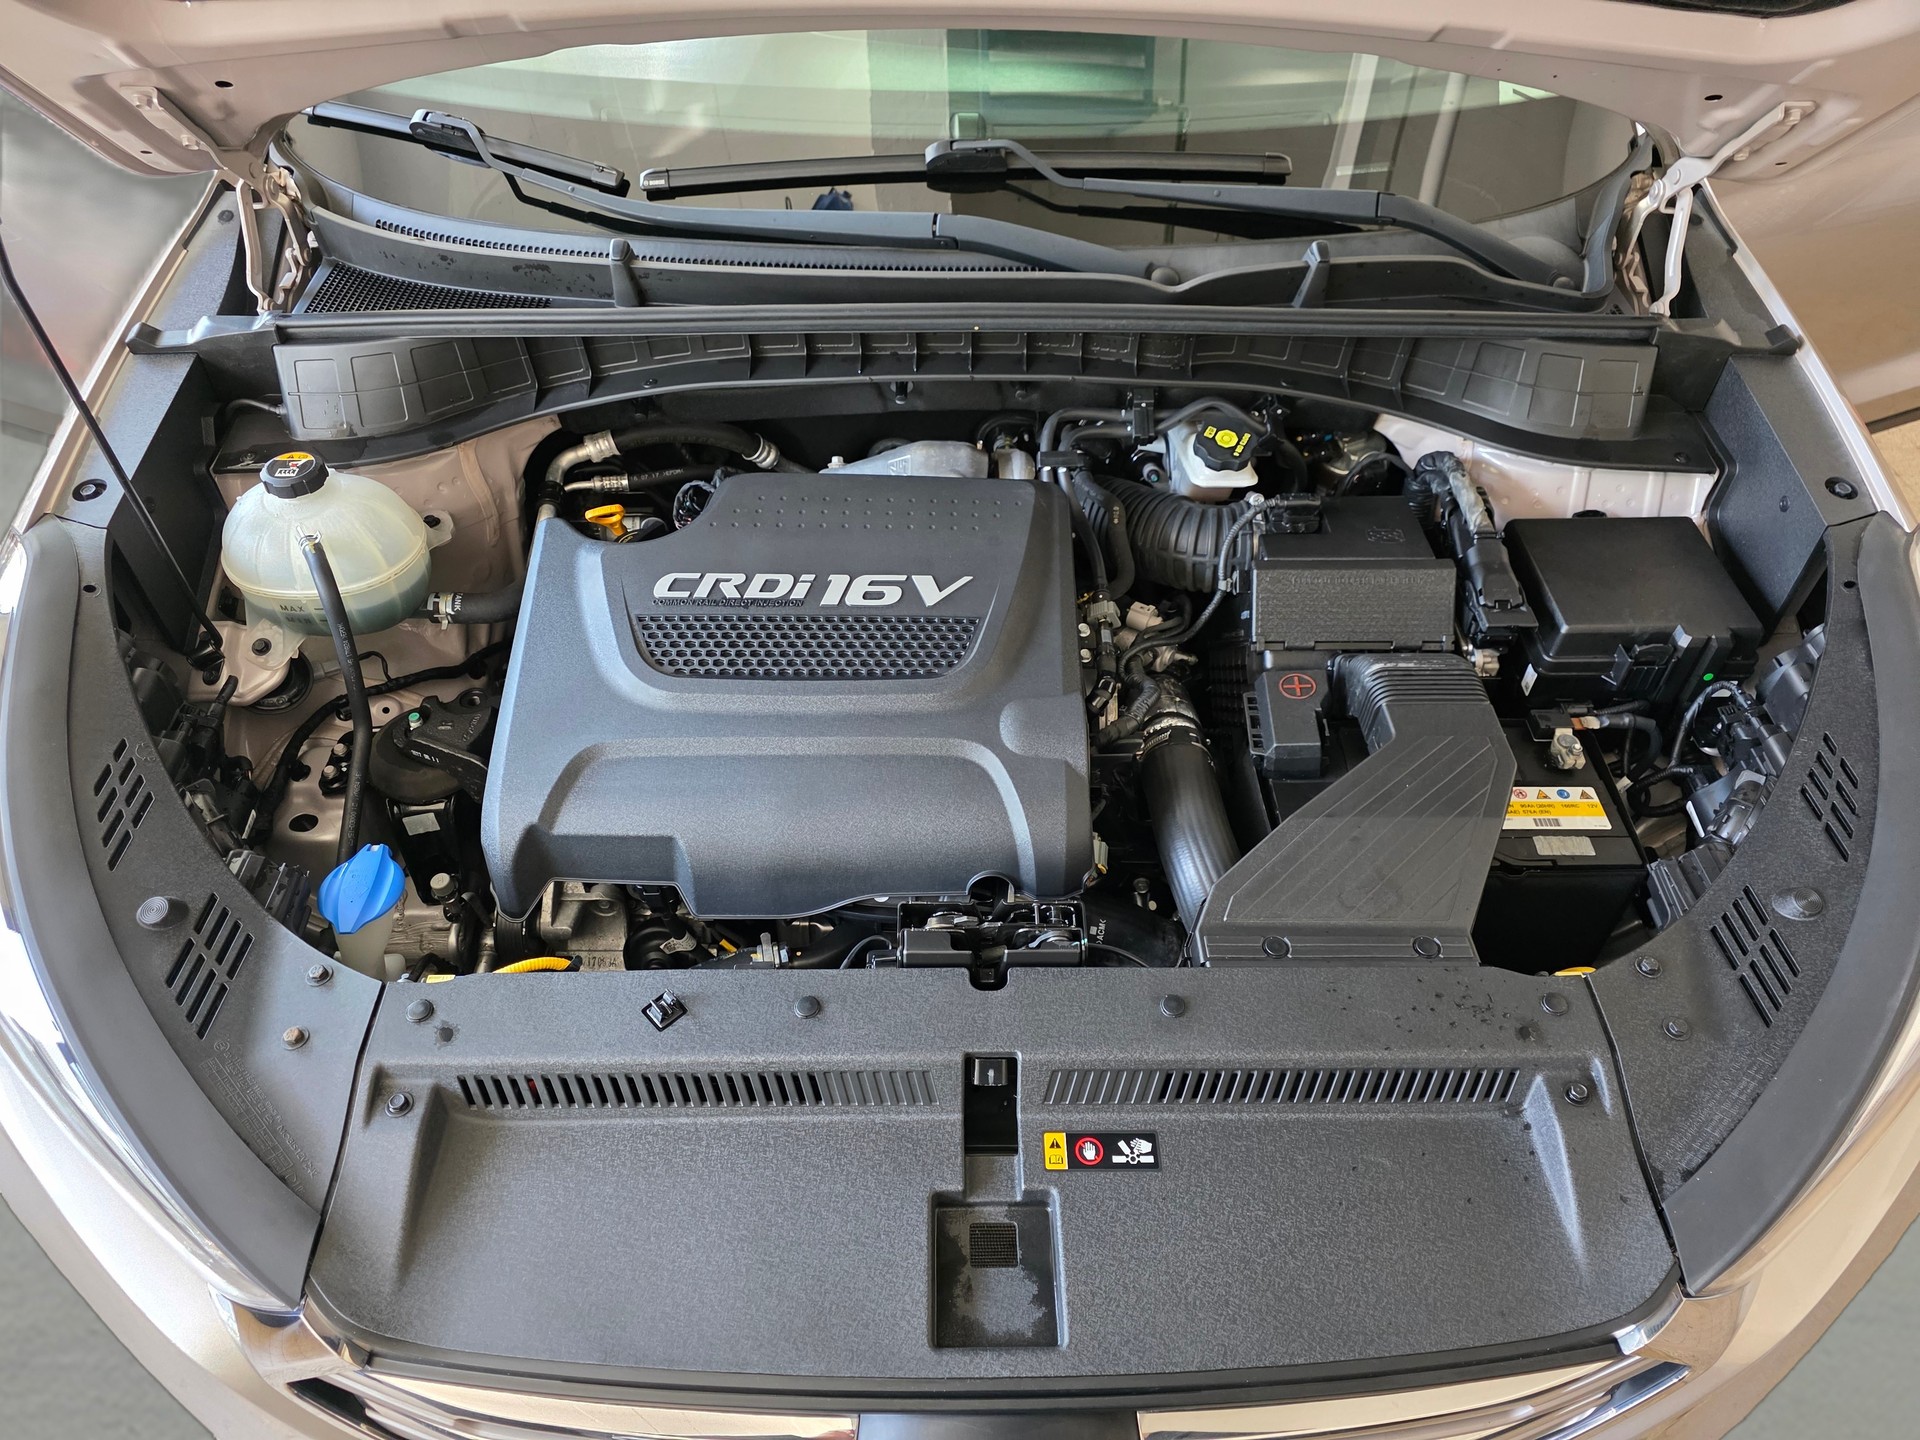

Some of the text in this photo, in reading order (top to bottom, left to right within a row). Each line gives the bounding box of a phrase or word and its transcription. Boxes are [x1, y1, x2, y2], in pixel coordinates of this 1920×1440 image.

[652, 572, 975, 607] CRDi 16V
[652, 599, 805, 608] COMMON RAIL DIRECT INJECTION
[279, 604, 305, 613] MAX
